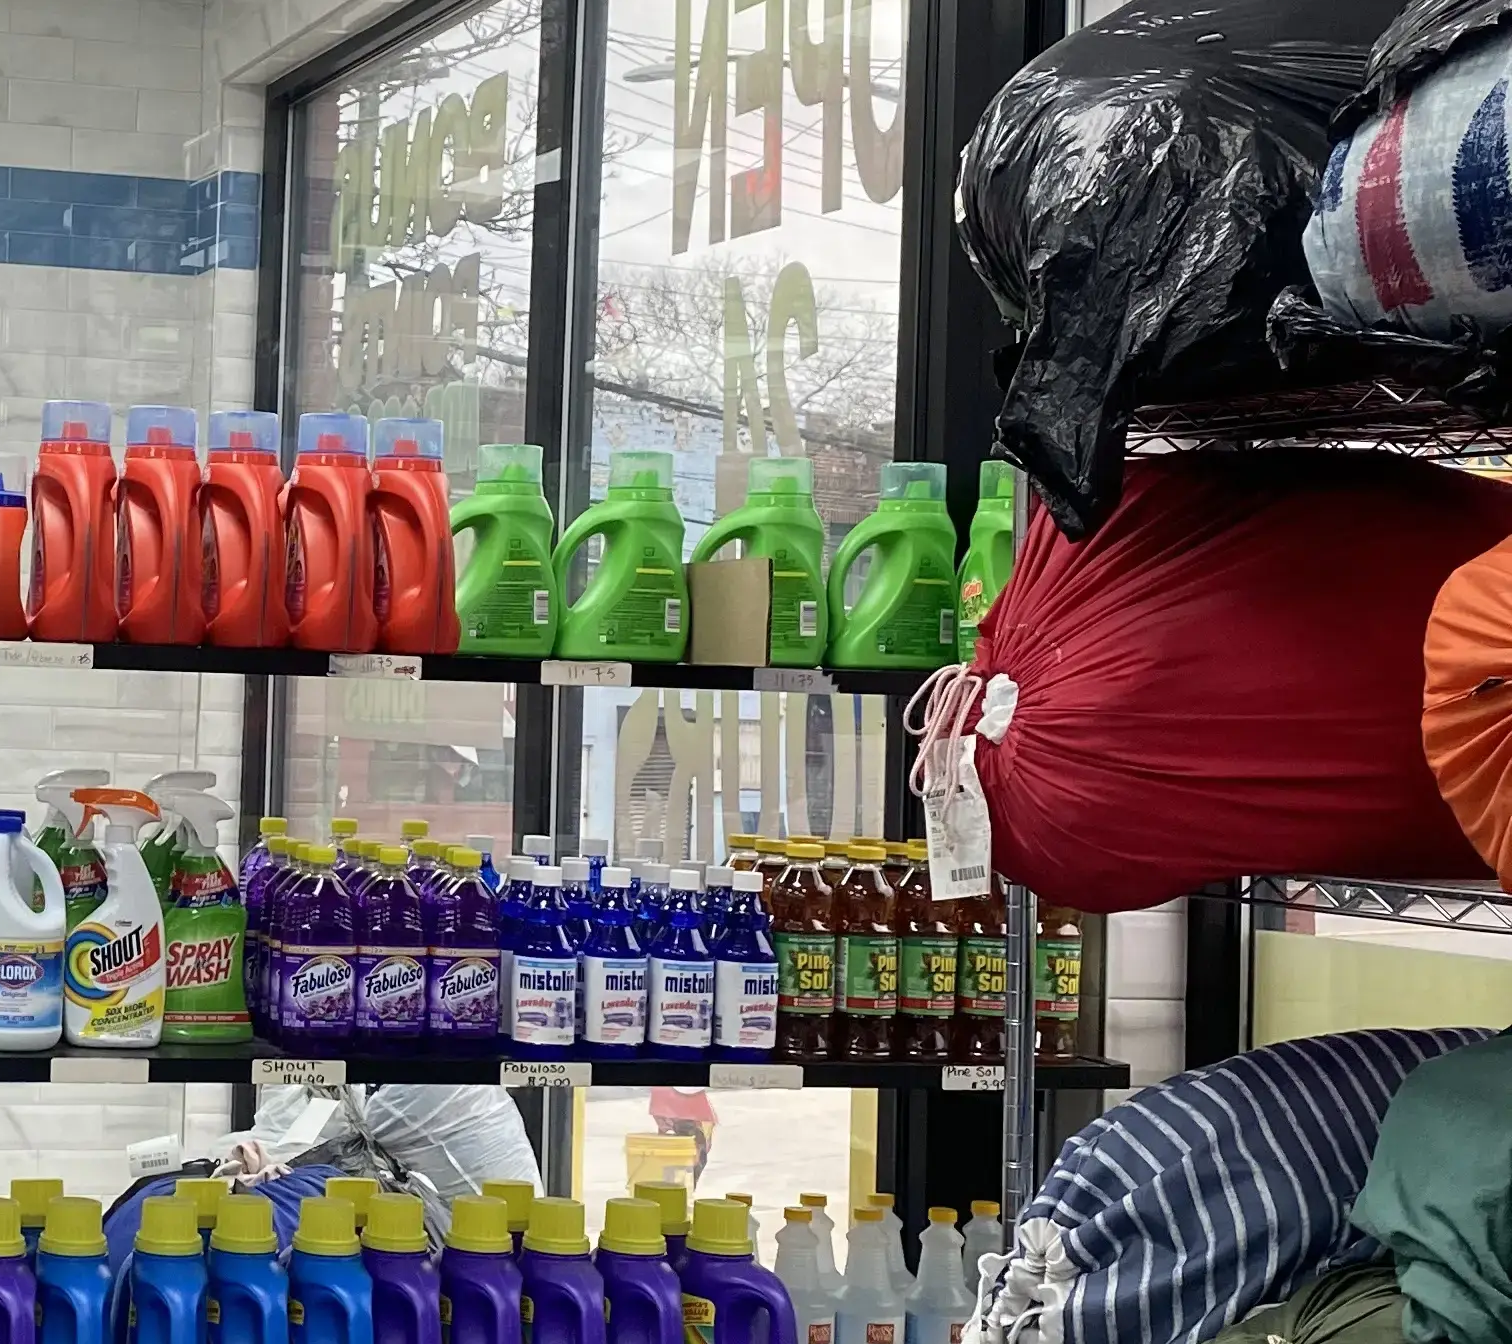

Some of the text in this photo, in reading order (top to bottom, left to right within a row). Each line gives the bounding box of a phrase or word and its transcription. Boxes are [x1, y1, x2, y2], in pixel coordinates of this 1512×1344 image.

[90, 926, 143, 976] SHOUT
[166, 933, 237, 968] SPRAY
[796, 953, 831, 971] Pine
[877, 955, 897, 972] Pin
[930, 955, 956, 973] Pin
[975, 955, 1006, 973] Pin
[1055, 957, 1080, 975] Pin
[165, 958, 232, 988] WASH
[291, 966, 352, 998] Fabuloso
[364, 965, 423, 998] Fabuloso
[799, 971, 830, 991] Sol
[879, 972, 896, 991] So
[439, 967, 496, 999] Fabuloso
[665, 972, 714, 994] mistoli
[504, 1063, 566, 1074] Fabuloso
[945, 1066, 997, 1078] Pine Sol
